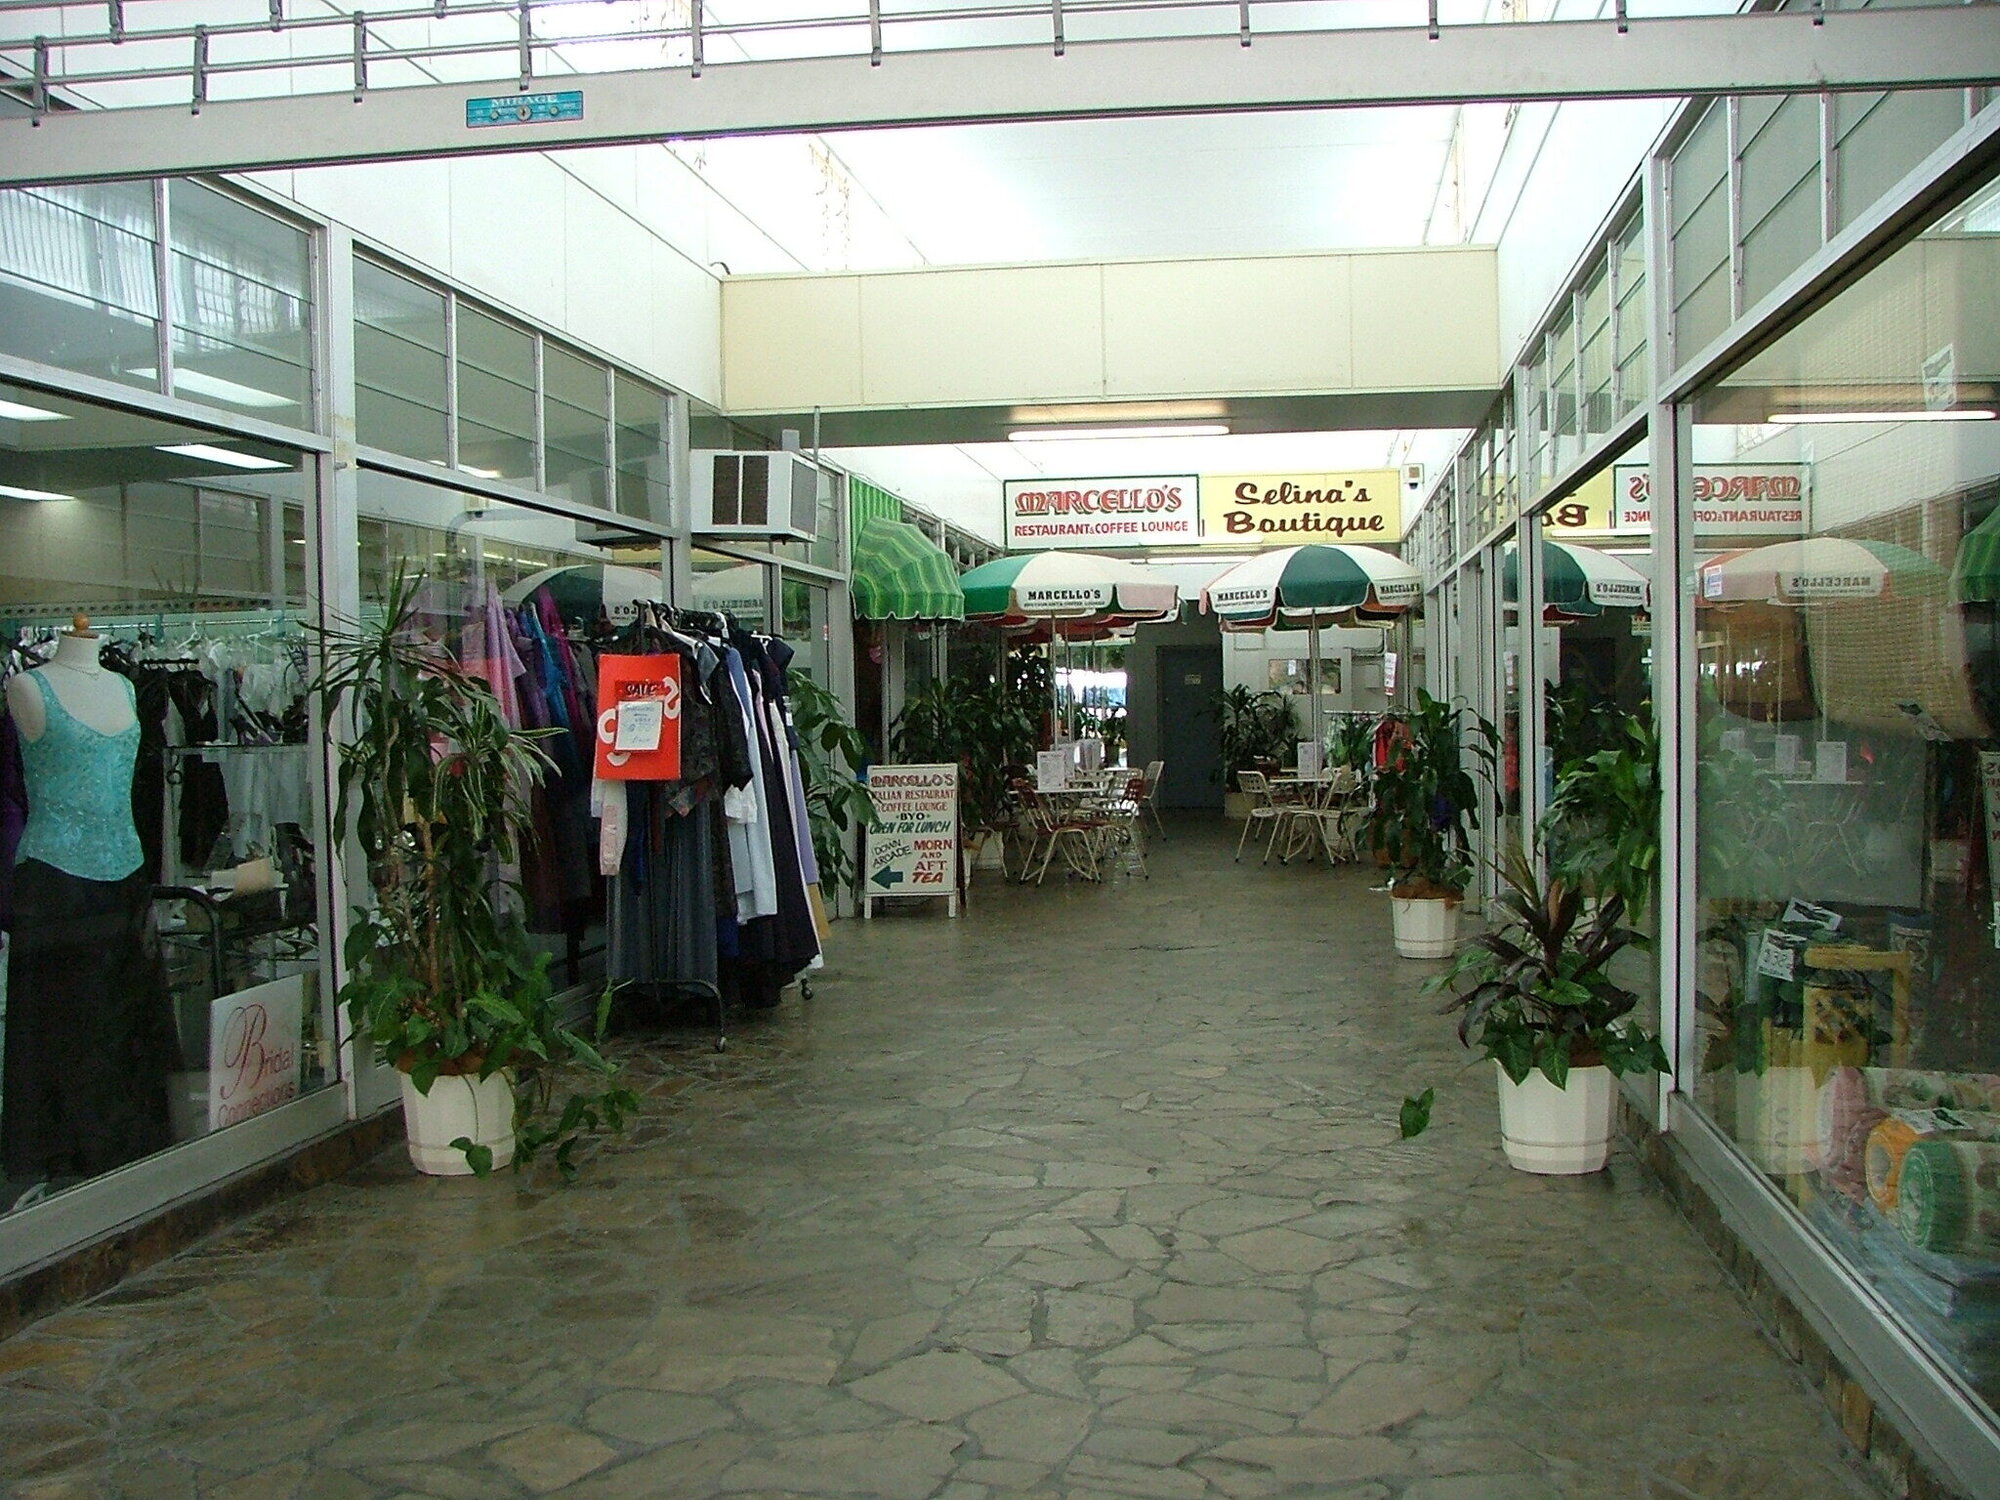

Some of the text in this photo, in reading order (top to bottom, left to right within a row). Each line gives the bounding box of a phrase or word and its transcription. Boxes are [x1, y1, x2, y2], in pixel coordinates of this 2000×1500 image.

[491, 95, 558, 107] MIRAGE
[1234, 480, 1372, 505] Selina's
[1015, 484, 1182, 516] MARCELLO'S
[1014, 524, 1090, 537] RESTAURANT
[1095, 522, 1138, 536] COFFEE
[1141, 520, 1188, 533] LOUNGE
[1223, 511, 1385, 537] Boutique
[1028, 589, 1101, 600] MARCELLO'S
[1217, 589, 1268, 601] MARCELLO'S
[870, 774, 954, 787] MARCELLO'S
[905, 789, 955, 799] RESTAURANT
[881, 802, 913, 813] COFFEE
[915, 802, 947, 812] LOUNGE
[900, 812, 925, 821] BYO
[897, 822, 914, 833] FOR
[915, 821, 951, 833] LUNCH
[874, 839, 902, 855] DOWN
[914, 840, 952, 851] MORN
[872, 845, 912, 868] ARCADE
[912, 872, 944, 883] TEA
